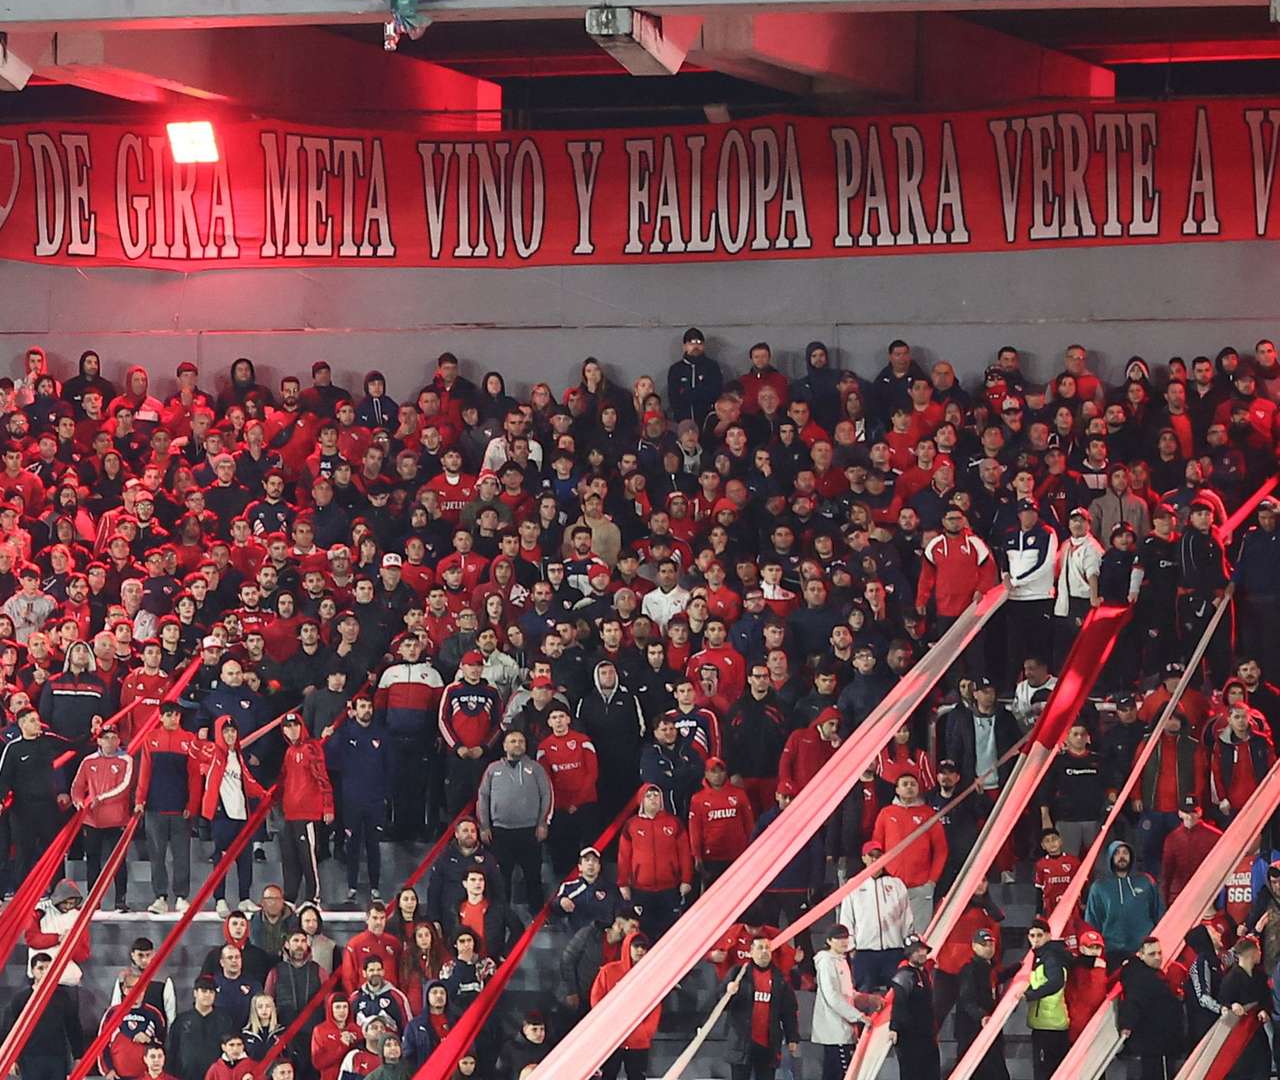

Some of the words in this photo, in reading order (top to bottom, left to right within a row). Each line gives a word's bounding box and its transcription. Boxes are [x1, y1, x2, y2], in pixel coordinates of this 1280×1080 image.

[27, 131, 97, 258] DE
[116, 133, 241, 260] GIRA
[260, 131, 398, 259] META
[417, 137, 547, 261] VINO
[565, 140, 604, 256] Y
[624, 123, 813, 256] FALOPA
[831, 119, 971, 249] PARA
[987, 111, 1162, 244] VERTE
[1180, 104, 1222, 236] A
